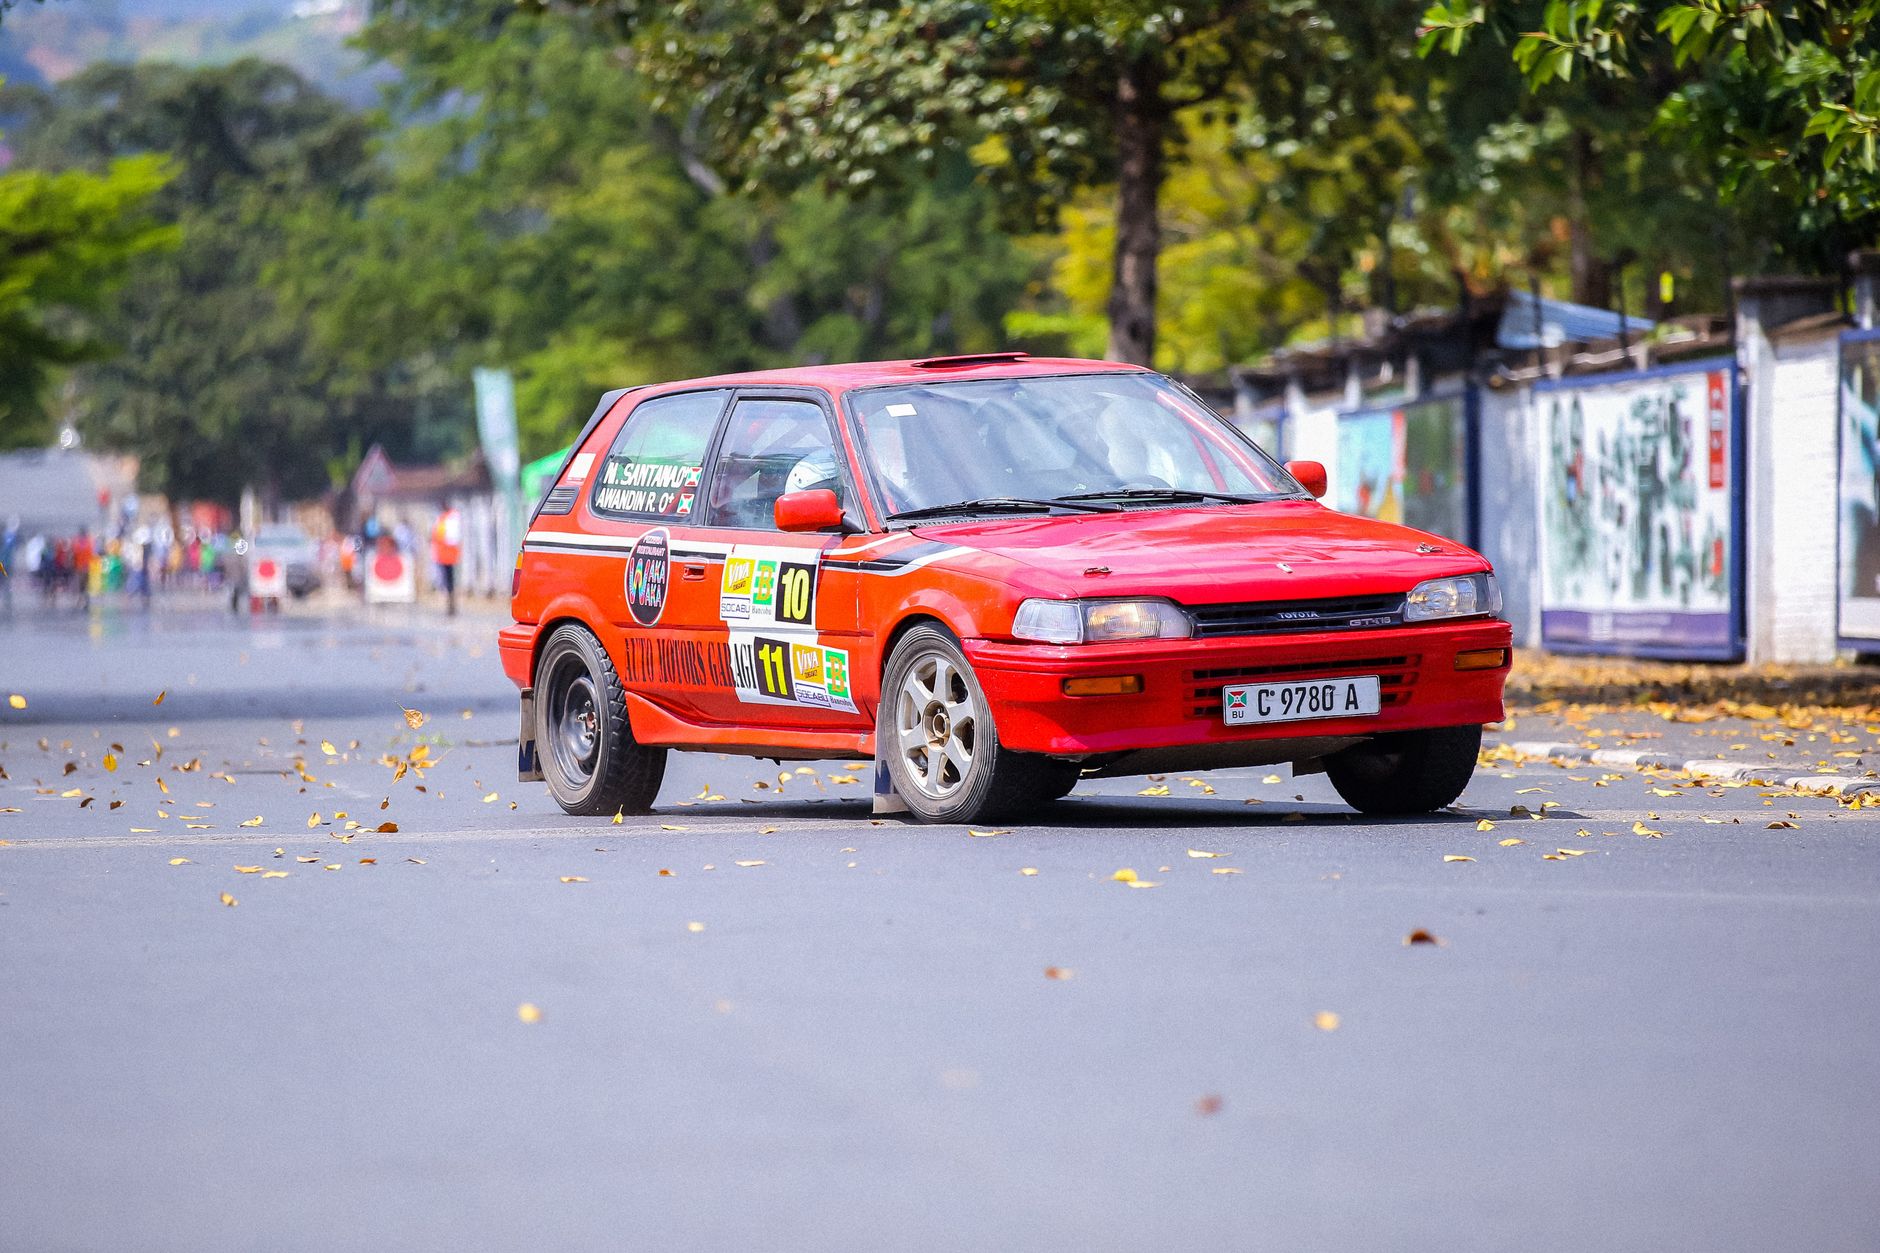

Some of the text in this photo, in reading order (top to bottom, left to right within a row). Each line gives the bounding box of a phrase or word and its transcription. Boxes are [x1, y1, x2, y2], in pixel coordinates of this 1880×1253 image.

[645, 492, 657, 512] R.
[782, 567, 809, 620] 10
[721, 602, 750, 613] SOCABU
[1279, 611, 1320, 619] TOYOTA
[625, 638, 654, 682] AUTO
[657, 638, 707, 686] MOTORS
[759, 643, 788, 695] 11
[796, 649, 819, 675] VIVA
[1281, 684, 1334, 715] 9780
[1345, 683, 1359, 710] A
[1232, 710, 1244, 719] BU
